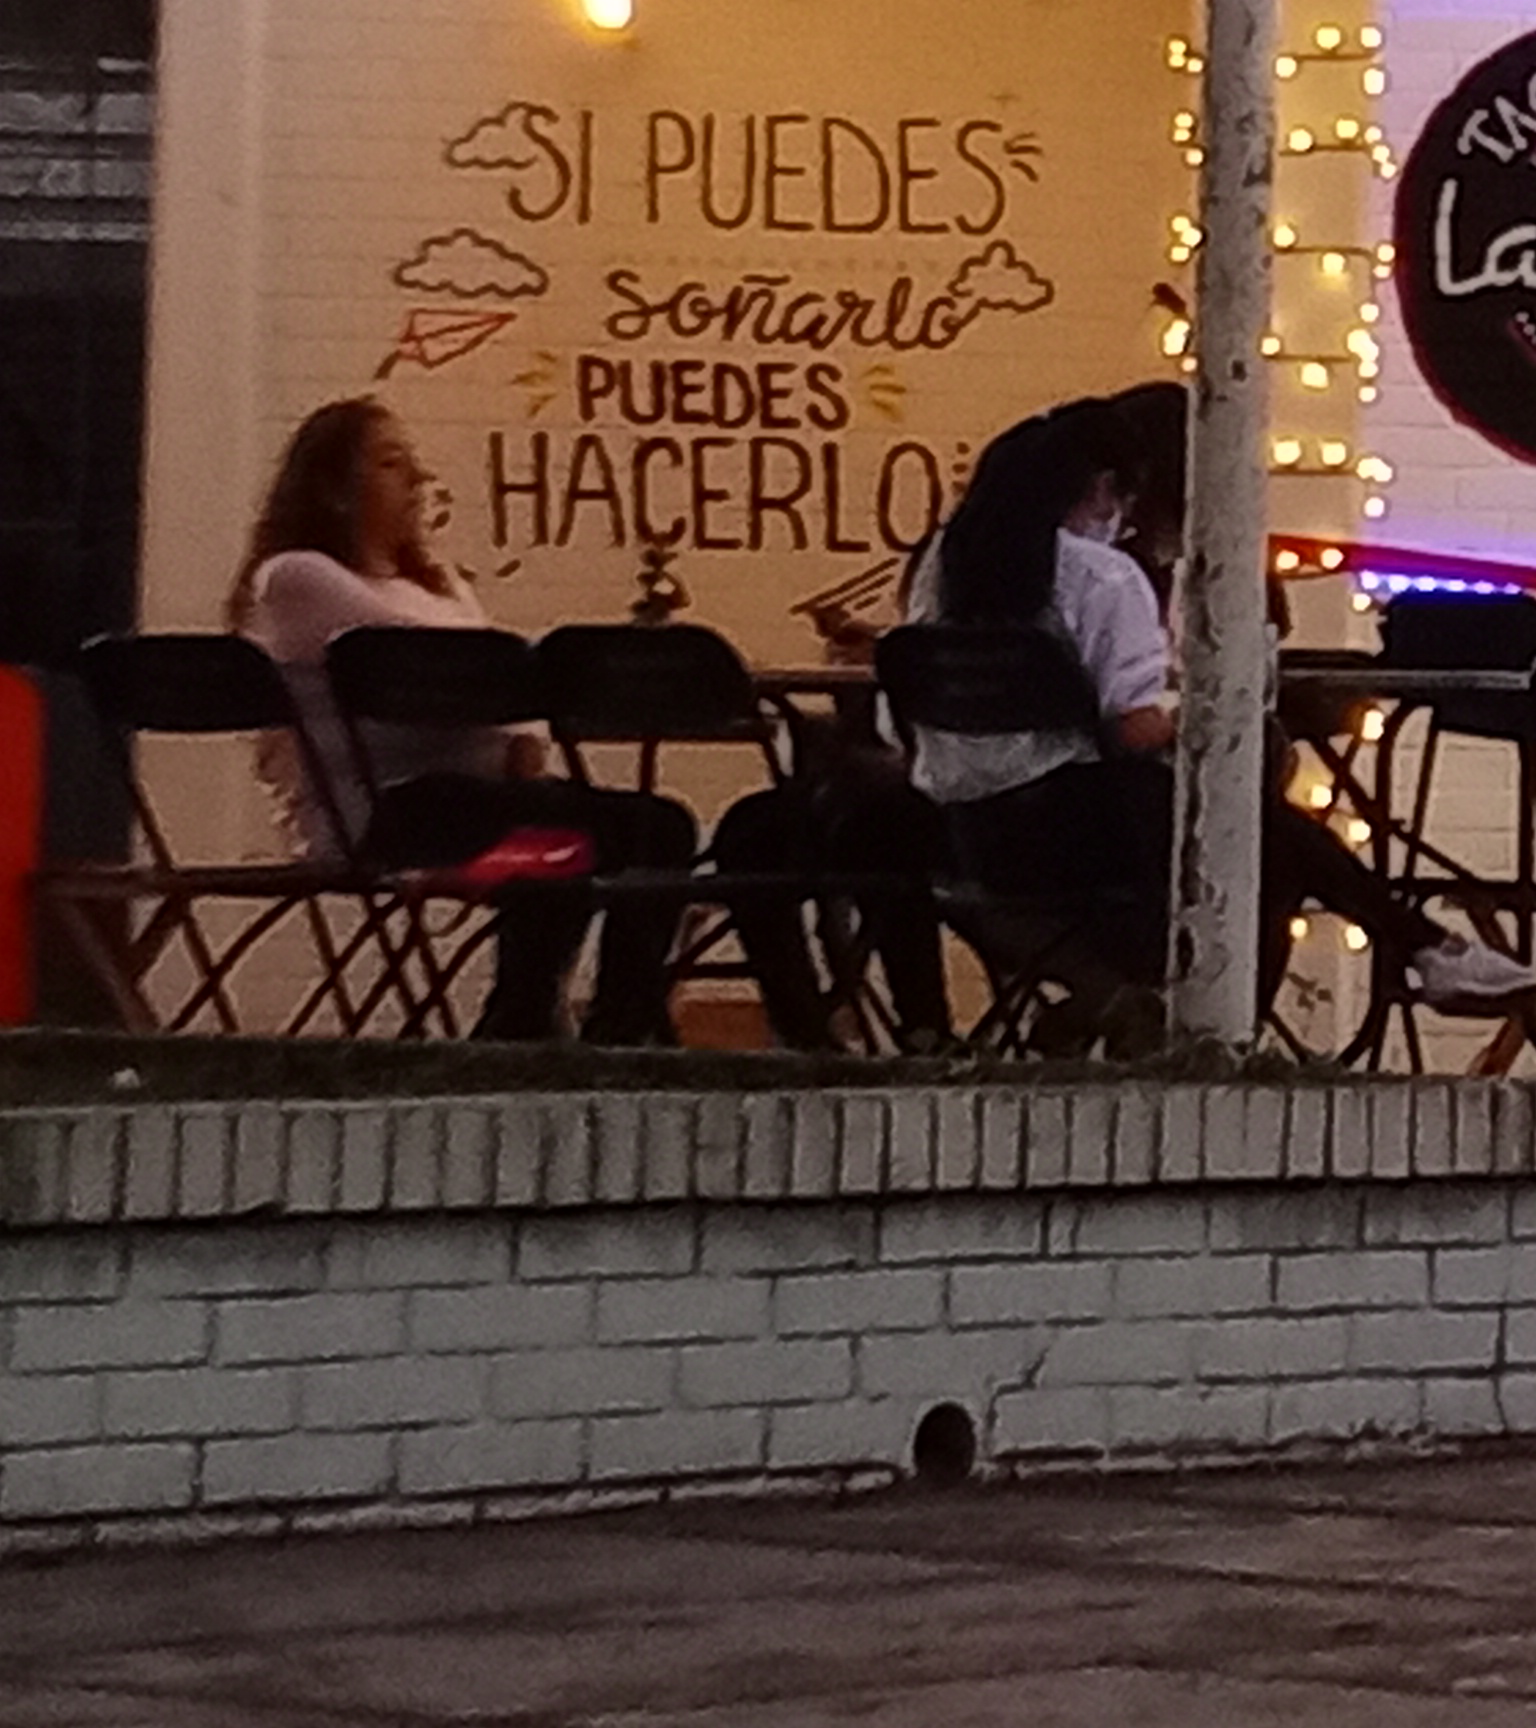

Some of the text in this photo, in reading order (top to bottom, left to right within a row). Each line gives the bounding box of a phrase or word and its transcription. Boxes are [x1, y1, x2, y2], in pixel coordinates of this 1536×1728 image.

[508, 104, 1005, 235] SI PUEDES
[576, 354, 851, 431] PUEDES
[488, 431, 943, 555] HACERLO
